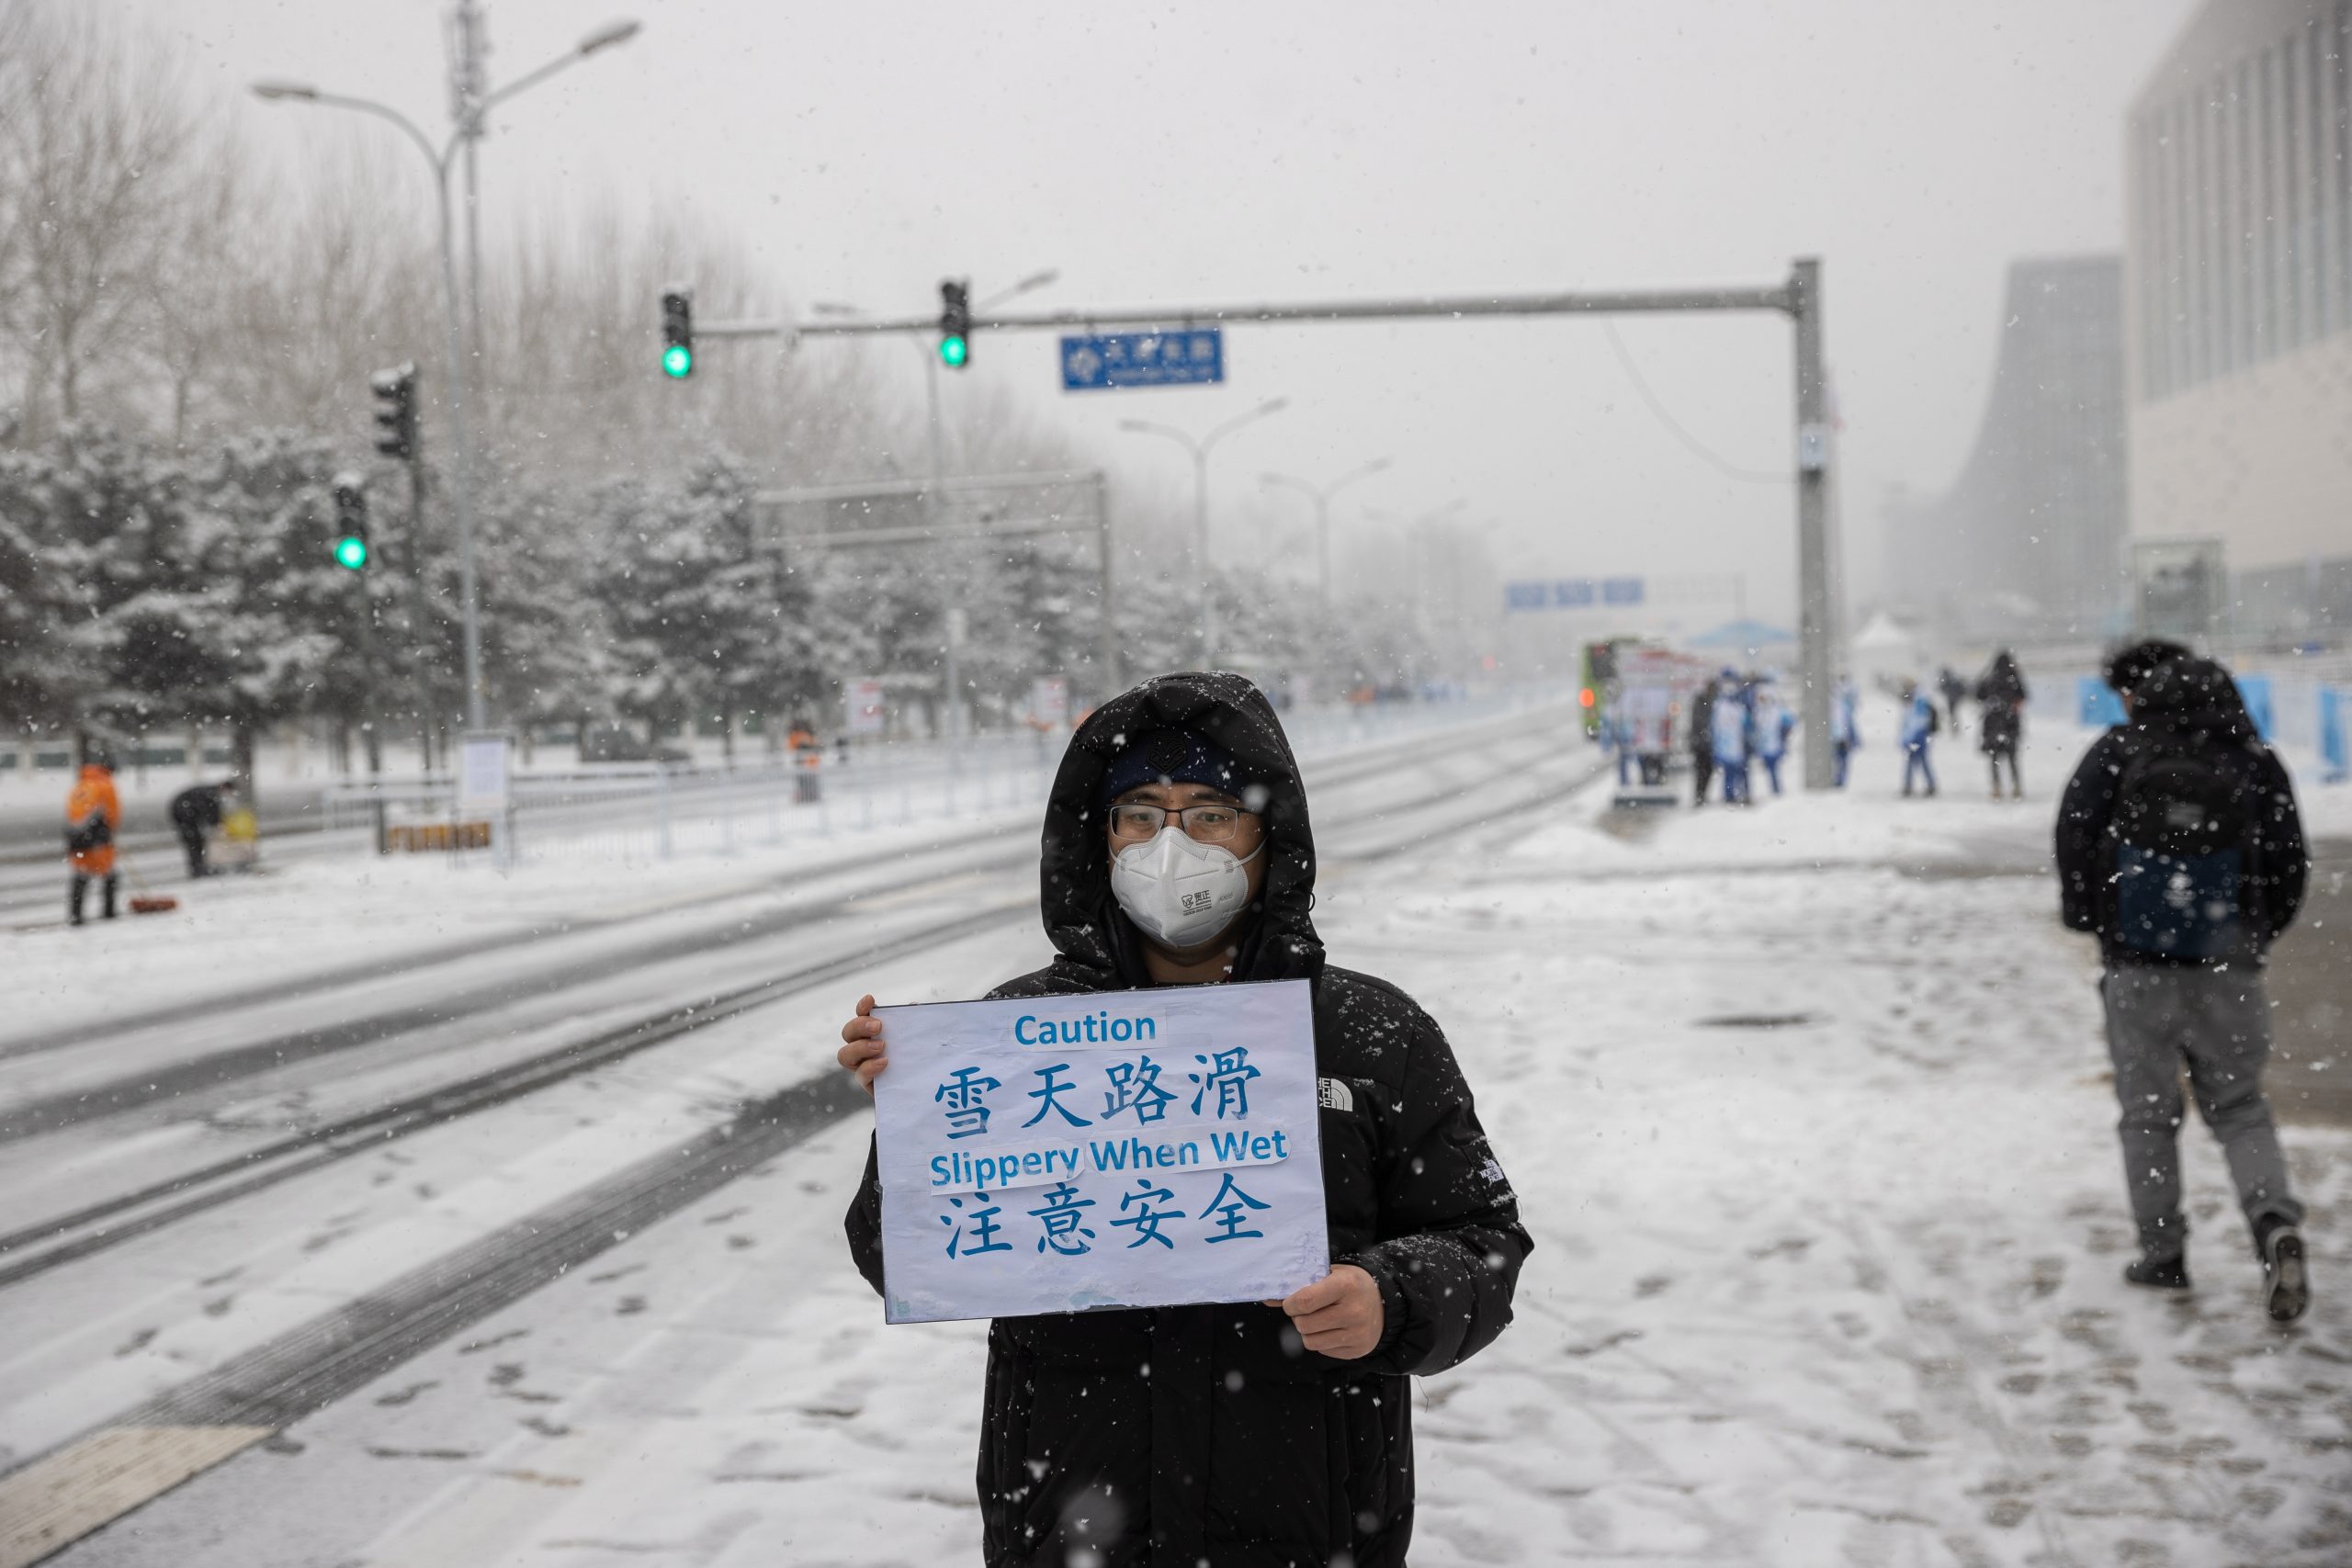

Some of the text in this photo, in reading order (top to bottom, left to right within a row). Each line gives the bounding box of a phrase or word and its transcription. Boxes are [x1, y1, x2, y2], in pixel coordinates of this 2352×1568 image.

[1014, 1011, 1156, 1046] Caution
[934, 1045, 1261, 1140] 雪天路滑
[930, 1130, 1288, 1189] Slippery When Wet
[940, 1172, 1272, 1260] 注意安全
